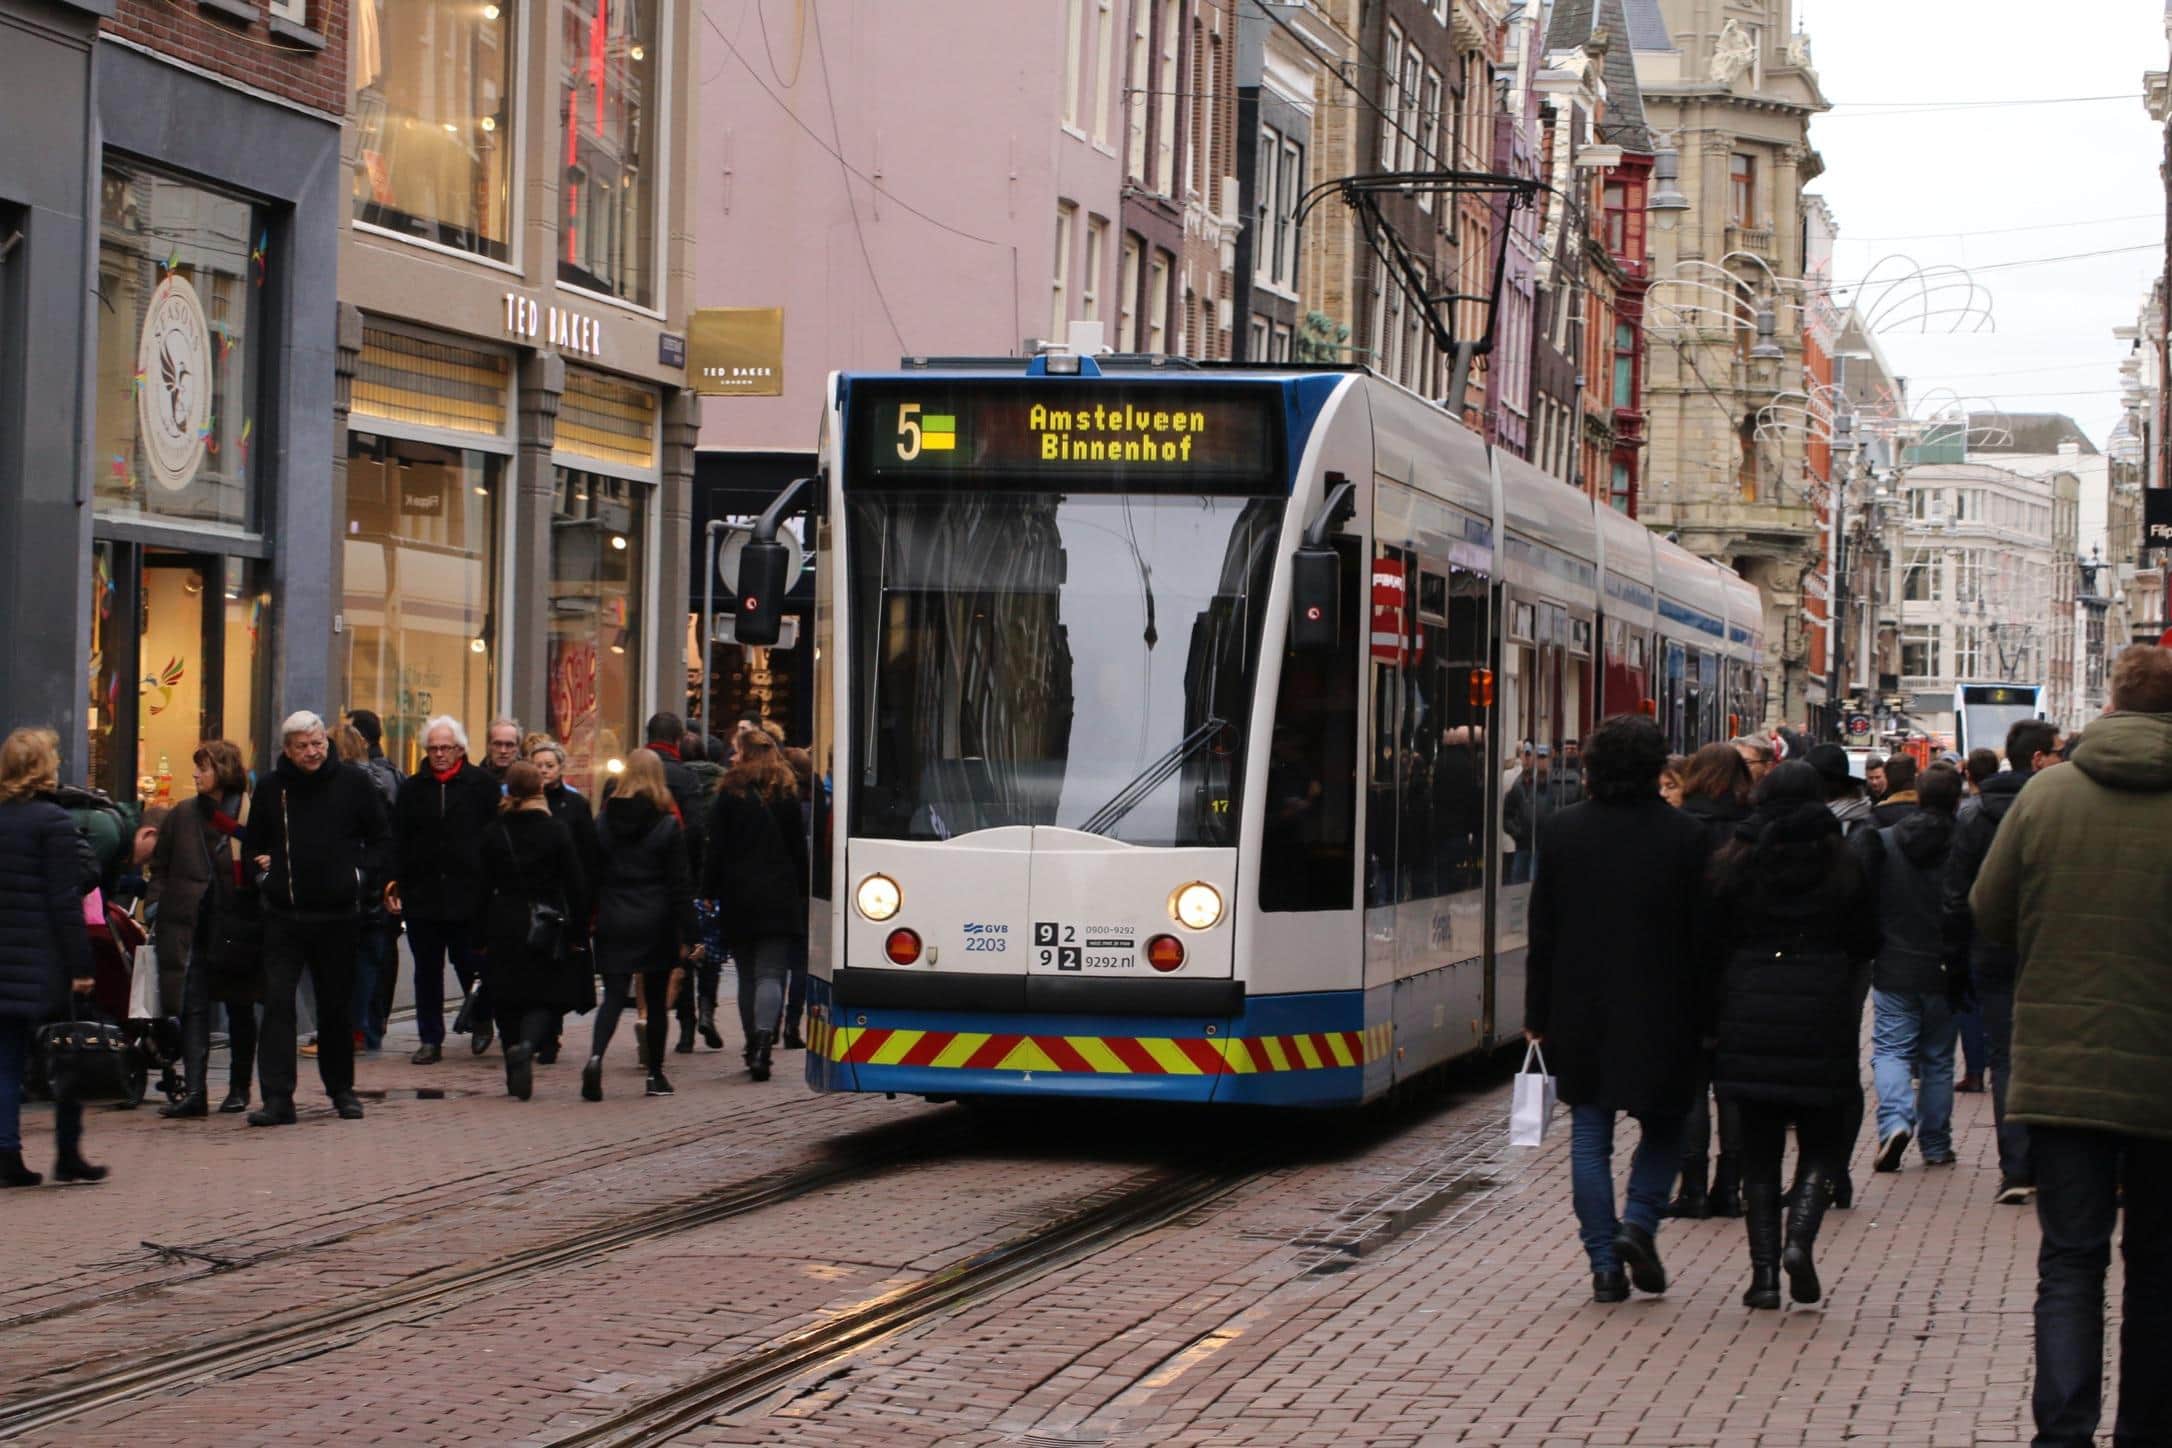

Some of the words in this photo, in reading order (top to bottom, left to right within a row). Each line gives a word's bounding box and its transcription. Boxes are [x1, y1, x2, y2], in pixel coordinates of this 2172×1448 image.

[505, 292, 538, 337] TED
[548, 306, 600, 356] BAKER
[703, 367, 726, 377] TED
[732, 367, 772, 377] BAKER
[1029, 403, 1206, 432] Amstelveen
[896, 403, 922, 461] 5
[1041, 432, 1193, 462] Binnenhof
[1211, 800, 1229, 815] 17
[985, 924, 1009, 934] GVB
[1085, 926, 1135, 935] 0900-9292
[965, 937, 1007, 952] 2203
[1085, 954, 1135, 969] 9292.nl
